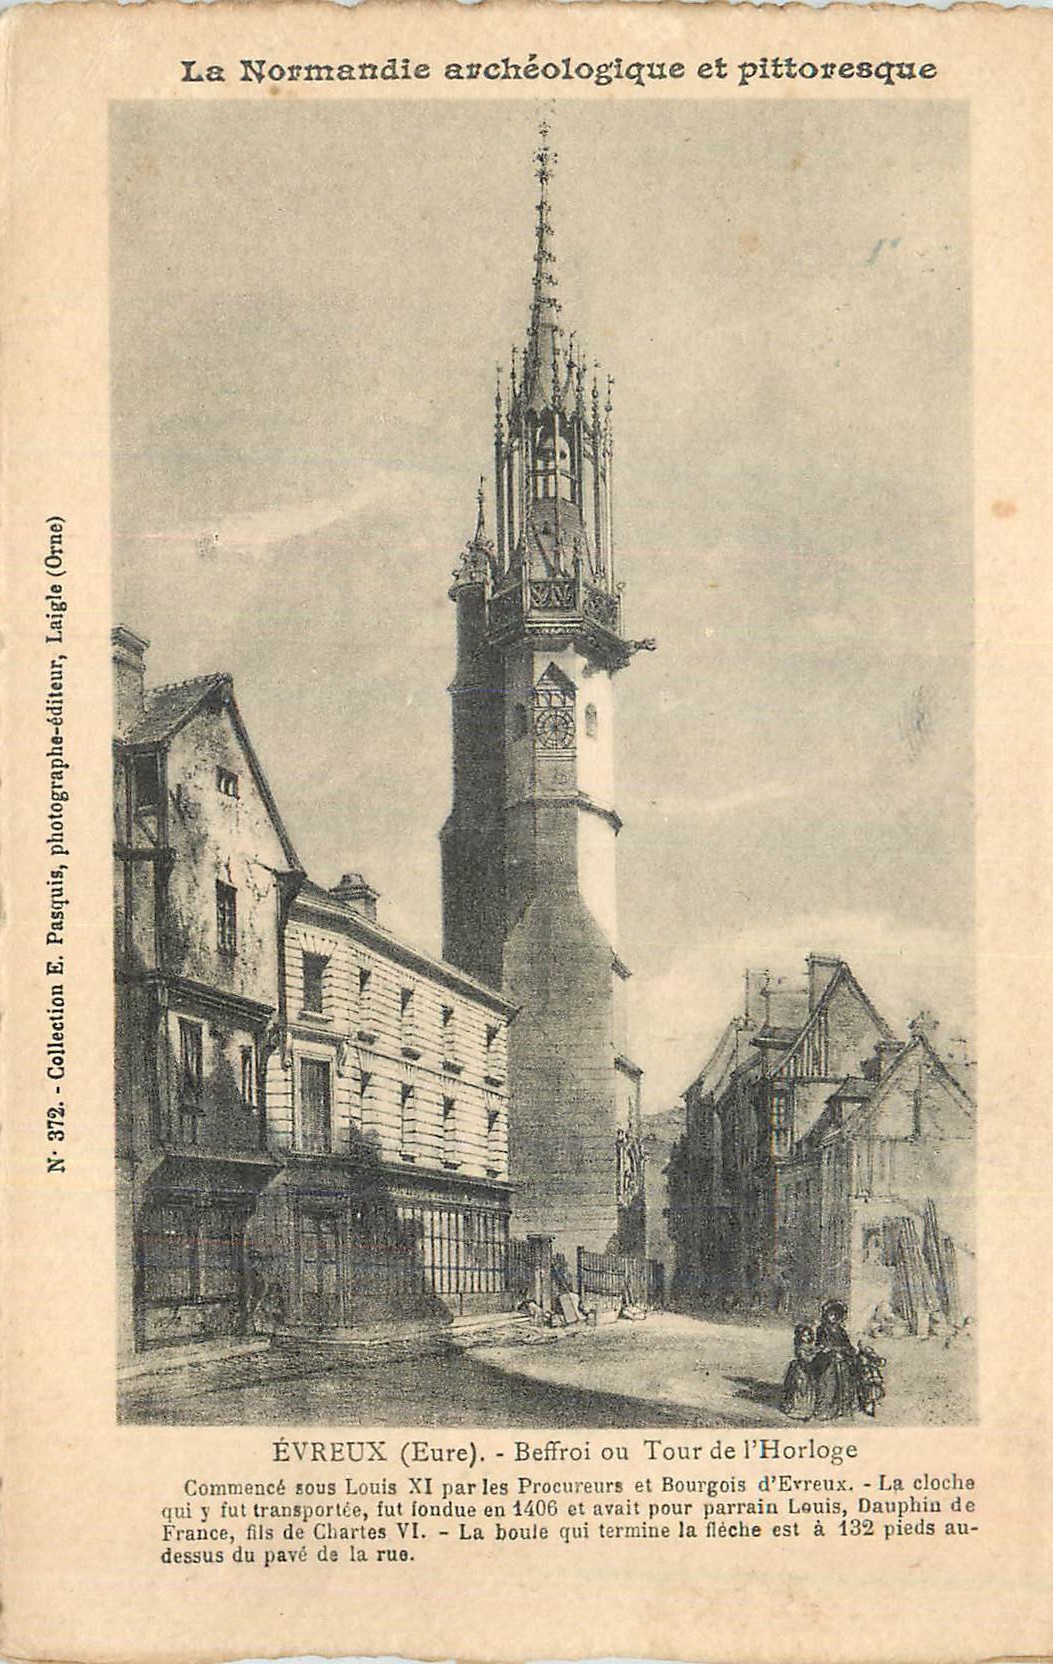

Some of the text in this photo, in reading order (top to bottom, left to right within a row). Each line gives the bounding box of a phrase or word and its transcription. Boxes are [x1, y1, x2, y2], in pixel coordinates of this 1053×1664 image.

[181, 54, 937, 86] La Normandie archéologique et pittoresque
[44, 516, 66, 577] (Orne)
[45, 585, 67, 643] Laigle
[46, 655, 69, 855] photographe-éditeur,
[46, 865, 69, 945] Pasquis,
[46, 956, 63, 975] E.
[46, 985, 65, 1079] Collection
[47, 1102, 65, 1141] 372.
[273, 1437, 387, 1462] ÉVREUX
[401, 1442, 484, 1468] (Eure).
[515, 1441, 590, 1461] Beffroi
[602, 1447, 628, 1460] ou
[644, 1440, 702, 1460] Tour
[710, 1440, 735, 1459] de
[745, 1438, 857, 1465] l'Horloge
[184, 1479, 285, 1496] Commencé
[296, 1483, 336, 1495] sous
[345, 1478, 396, 1495] Louis
[409, 1478, 432, 1494] XI
[442, 1483, 476, 1499] par
[483, 1478, 508, 1495] les
[518, 1478, 623, 1494] Procureurs
[635, 1479, 652, 1492] et
[662, 1476, 745, 1497] Bourgois
[758, 1475, 853, 1492] d'Evreux.
[880, 1475, 904, 1491] La
[914, 1473, 975, 1490] cloche
[162, 1502, 192, 1523] qui
[201, 1507, 209, 1523] y
[221, 1501, 246, 1518] fut
[254, 1502, 368, 1522] transportée,
[378, 1501, 402, 1517] fut
[484, 1506, 505, 1517] en
[513, 1500, 557, 1517] 1406
[568, 1503, 585, 1516] et
[594, 1499, 639, 1516] avait
[649, 1504, 692, 1519] pour
[704, 1499, 778, 1519] parrain
[789, 1498, 847, 1517] Louis,
[859, 1496, 941, 1518] Dauphin
[951, 1497, 975, 1512] de
[163, 1525, 234, 1544] France,
[247, 1524, 273, 1540] fils
[283, 1523, 304, 1540] de
[396, 1522, 425, 1539] VI.
[460, 1524, 484, 1540] La
[495, 1523, 548, 1540] boule
[560, 1522, 588, 1543] qui
[599, 1522, 669, 1538] termine
[679, 1521, 697, 1538] la
[773, 1523, 799, 1537] est
[814, 1520, 825, 1536] à
[839, 1519, 874, 1536] 132
[885, 1519, 935, 1540] pieds
[945, 1523, 978, 1535] au-
[161, 1545, 414, 1567] dessus du pavé de la rue.
